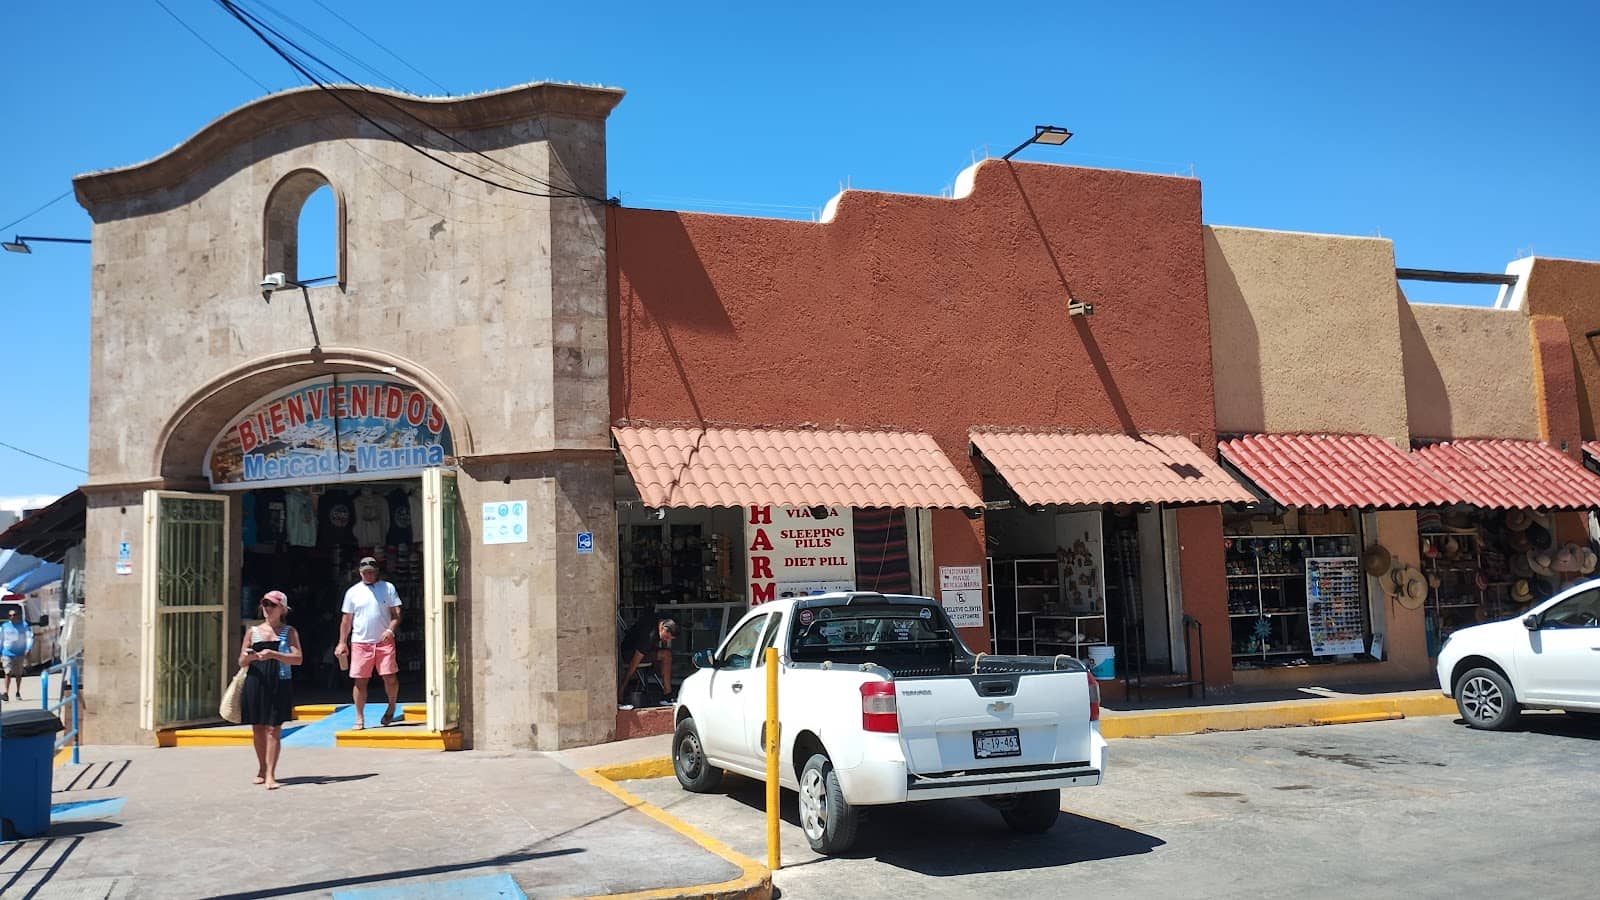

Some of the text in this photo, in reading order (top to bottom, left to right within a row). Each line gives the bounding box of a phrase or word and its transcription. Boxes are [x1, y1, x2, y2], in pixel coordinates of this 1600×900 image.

[238, 385, 445, 453] BIENVENIDOS
[243, 443, 445, 480] Mercado Marina
[786, 507, 839, 518] VIAA
[780, 528, 845, 539] SLEEPING
[795, 539, 831, 548] PILLS
[784, 557, 848, 567] DIET PILL
